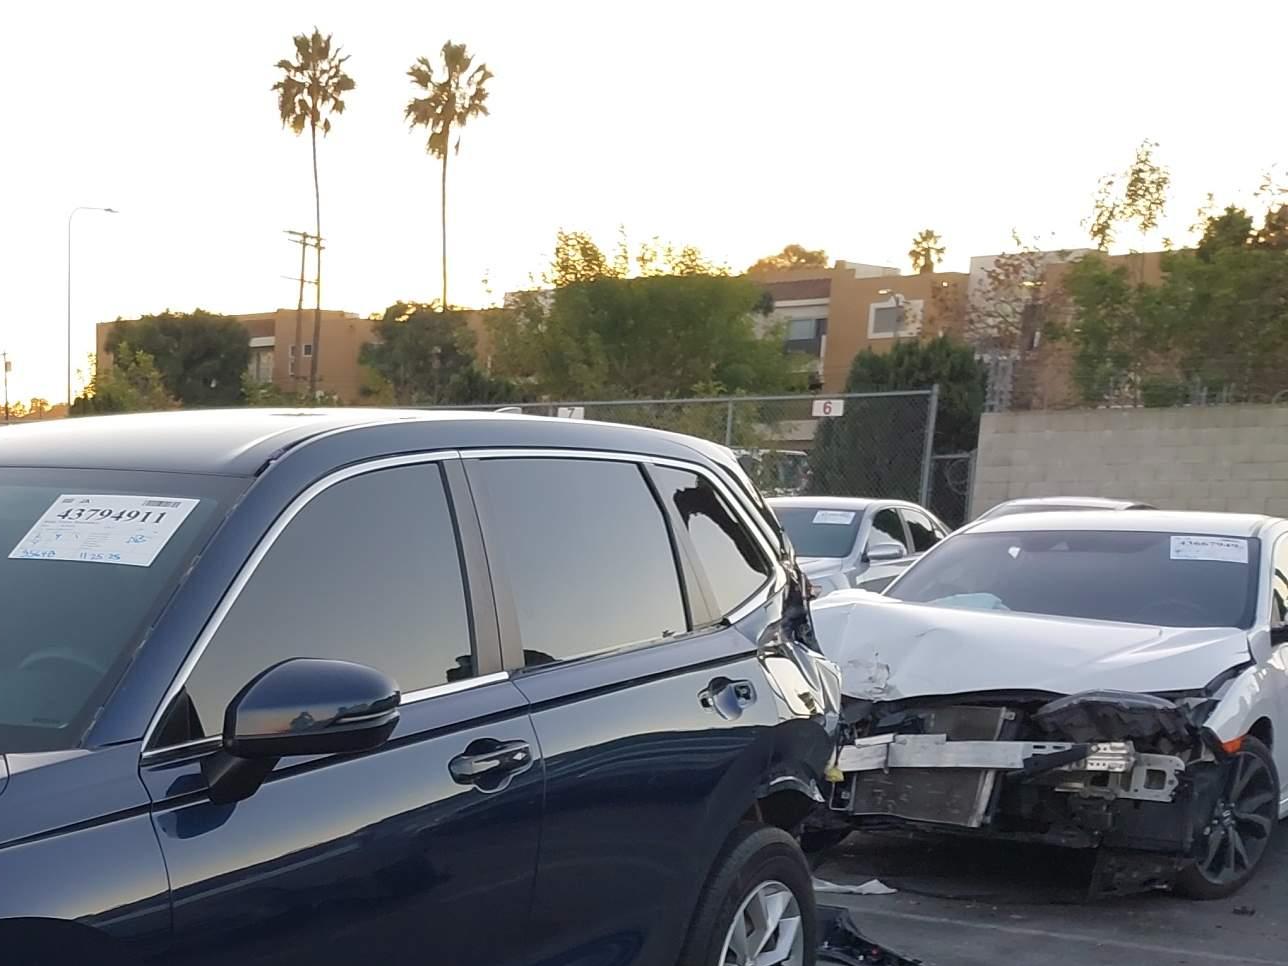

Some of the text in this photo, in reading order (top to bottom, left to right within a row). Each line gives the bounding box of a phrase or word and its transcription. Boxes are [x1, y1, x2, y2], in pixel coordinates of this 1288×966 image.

[567, 407, 576, 418] 7
[823, 401, 832, 415] 6
[57, 508, 167, 524] 43794911
